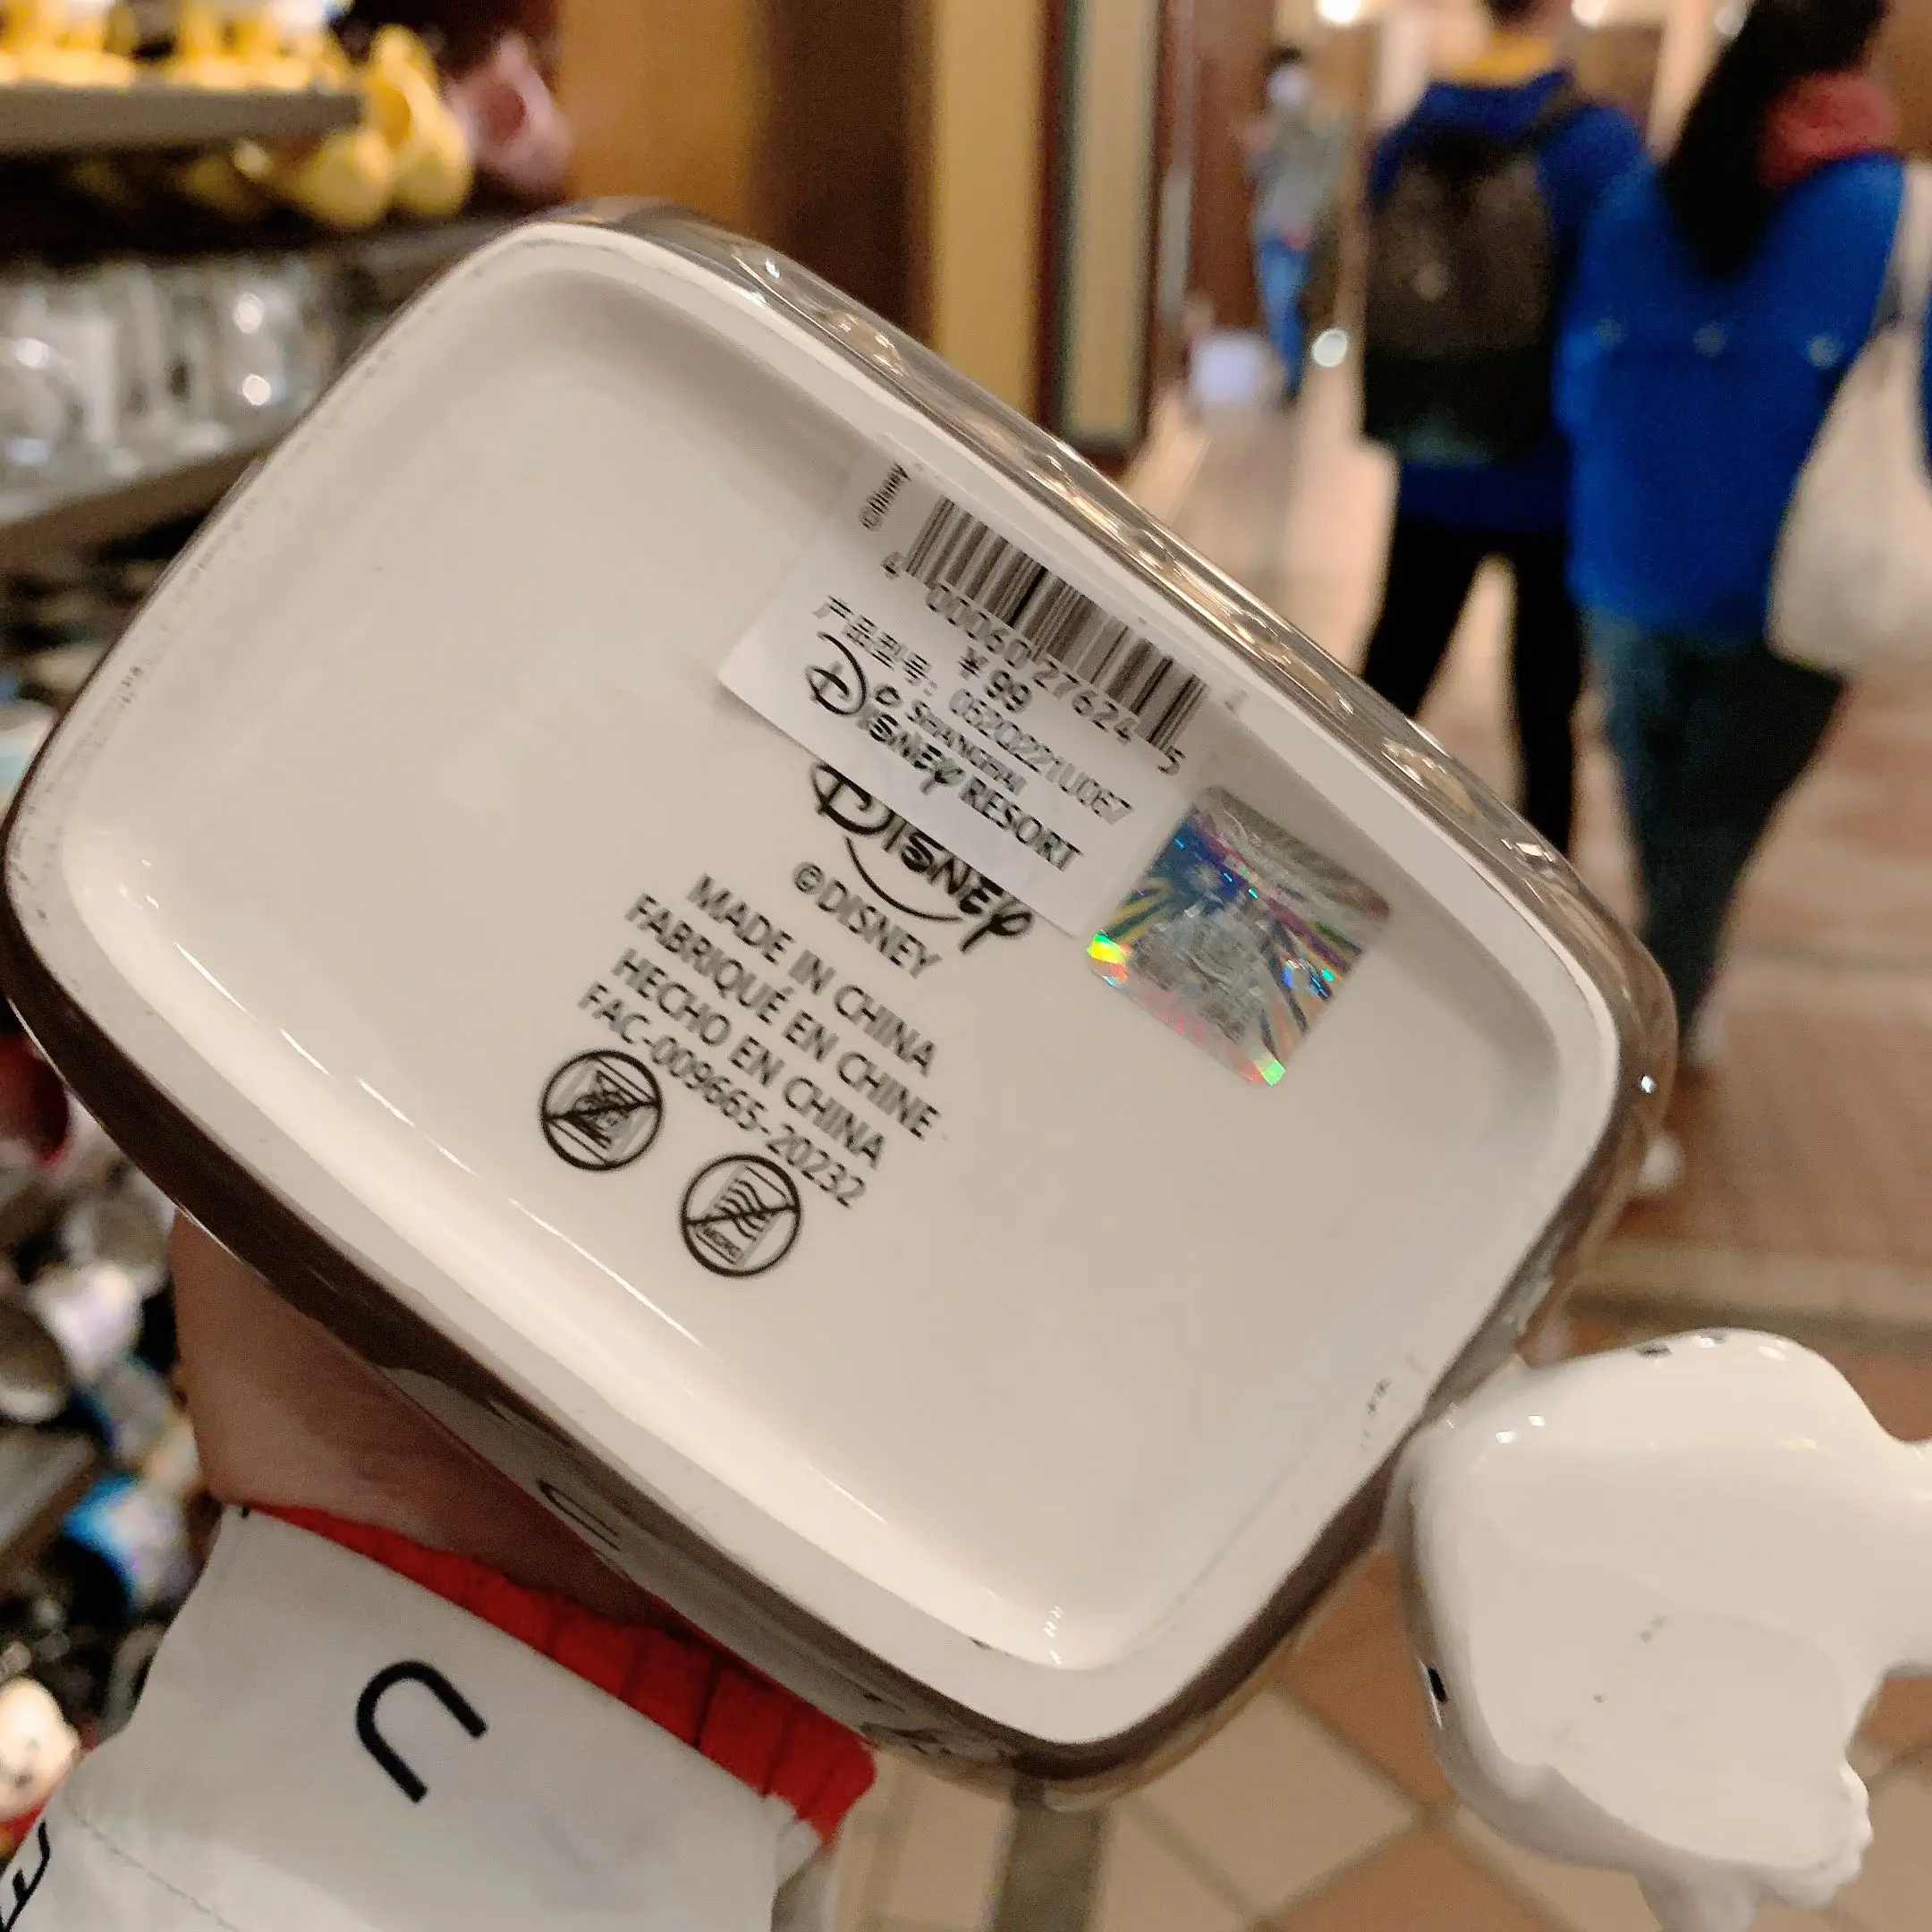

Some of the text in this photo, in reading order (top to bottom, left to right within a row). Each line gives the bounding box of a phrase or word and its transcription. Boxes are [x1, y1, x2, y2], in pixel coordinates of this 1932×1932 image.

[881, 550, 905, 579] 4
[1157, 744, 1186, 775] 5
[959, 775, 1082, 871] RESORT
[611, 949, 886, 1170] HECHO EN CHINA
[625, 893, 940, 1140] FABRIQUÉ EN CHINE
[686, 872, 936, 1078] MADE IN CHINA
[577, 980, 866, 1209] FAC-009665-20232
